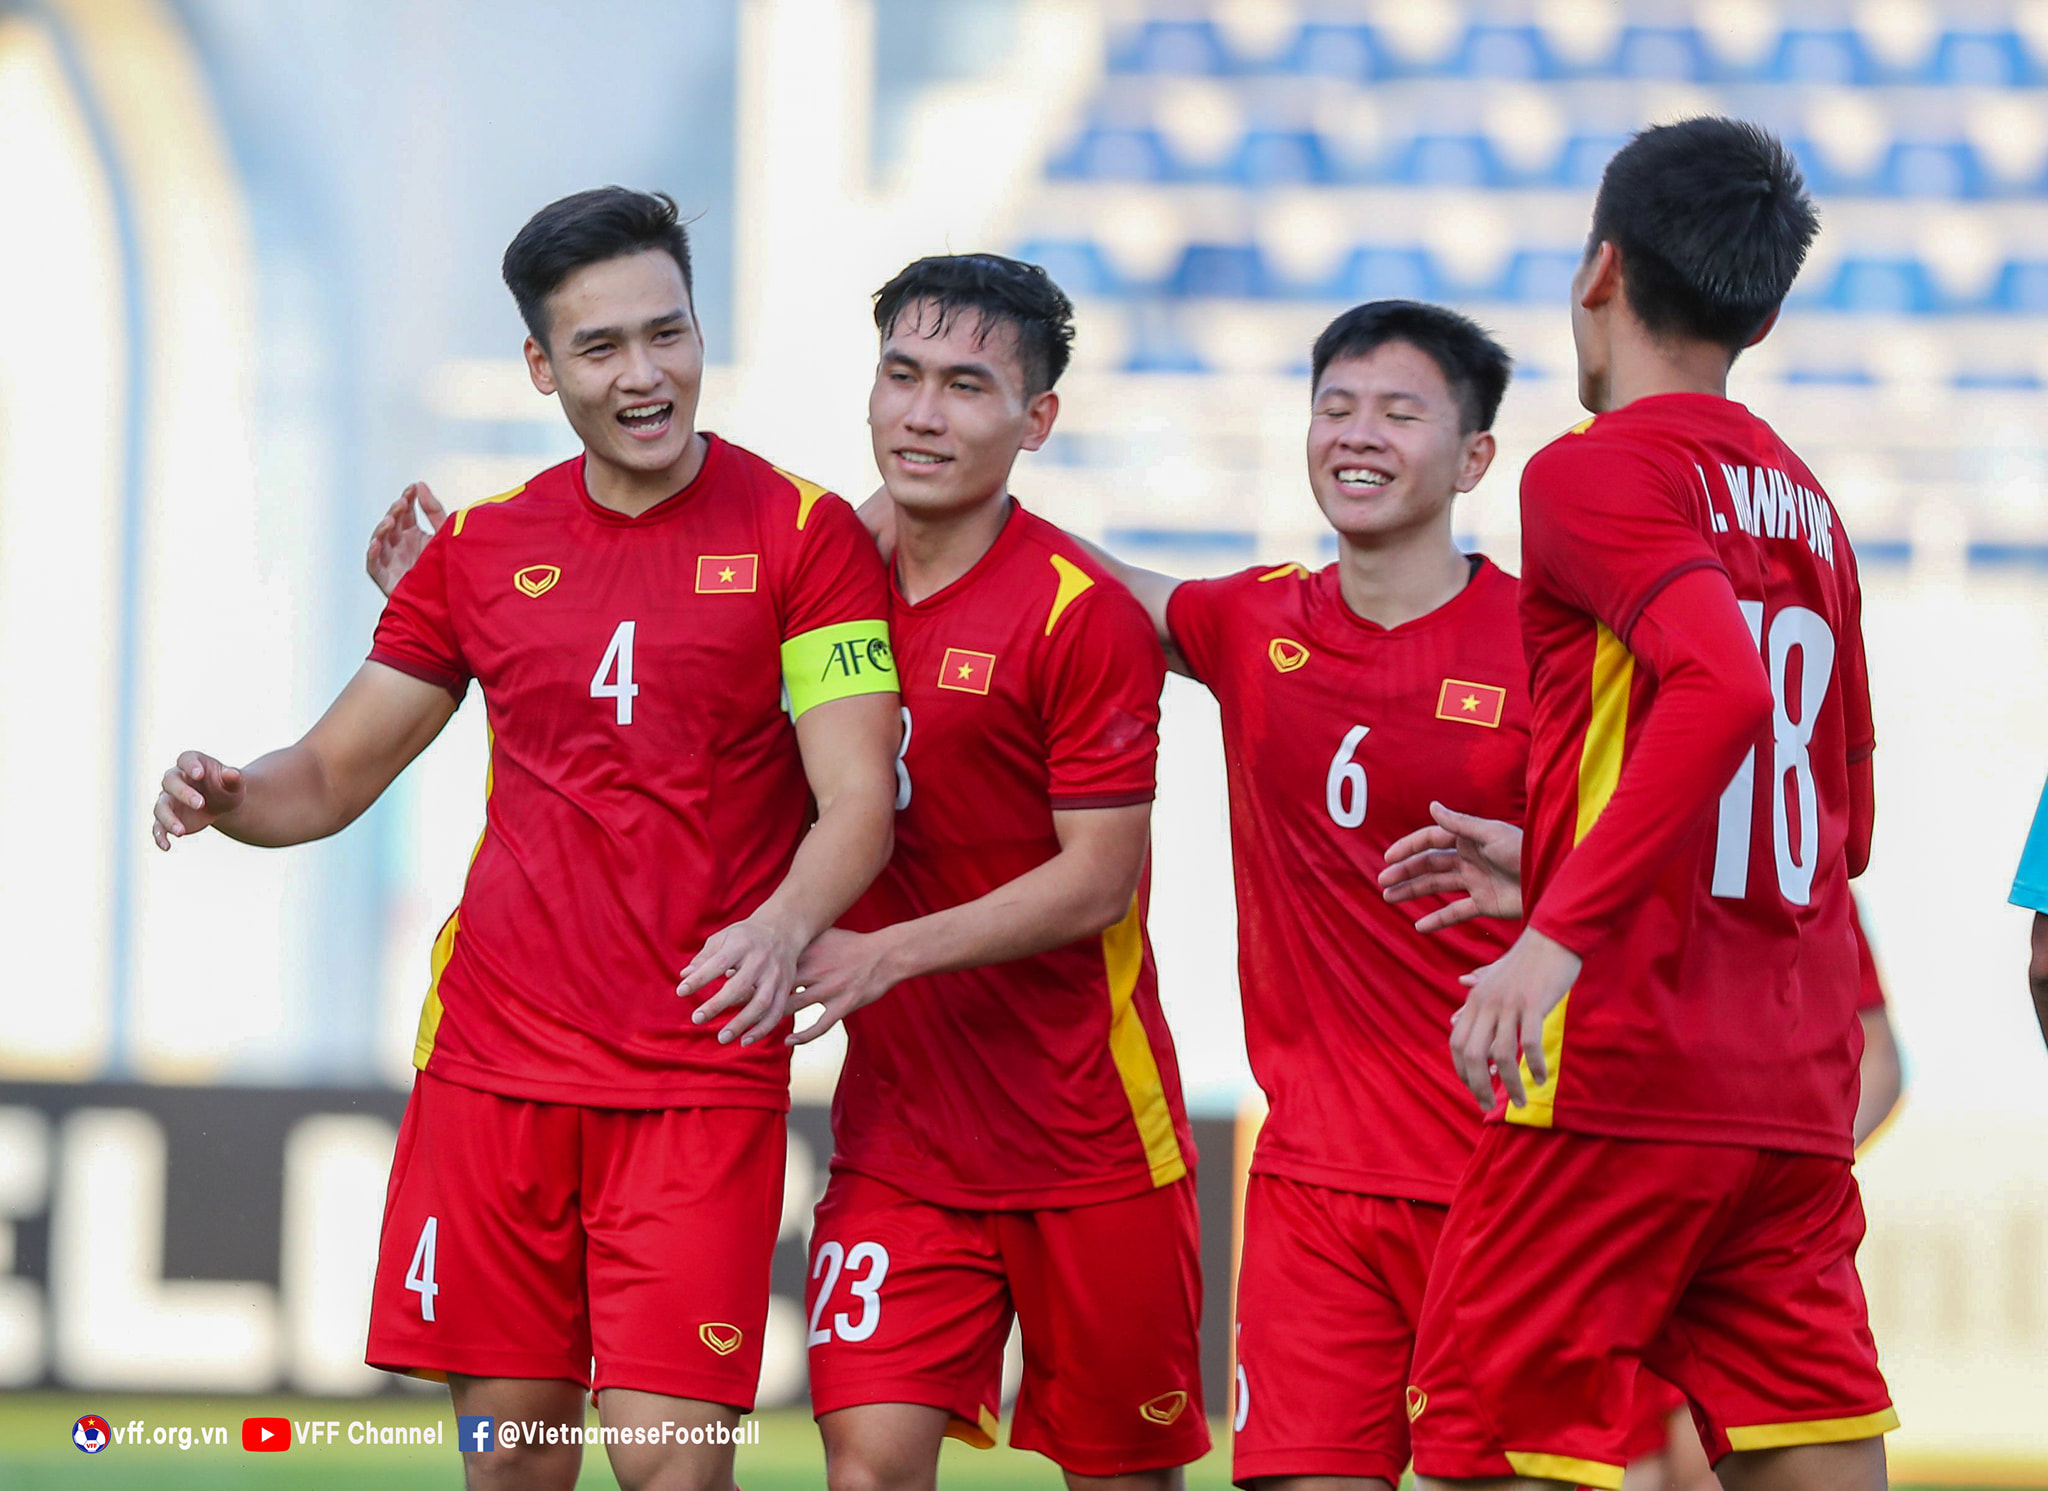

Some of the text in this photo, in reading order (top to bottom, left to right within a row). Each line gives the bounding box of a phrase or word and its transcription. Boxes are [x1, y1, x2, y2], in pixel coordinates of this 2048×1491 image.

[590, 621, 639, 725] 4
[821, 638, 893, 682] AFC
[1326, 725, 1371, 828] 6
[405, 1216, 439, 1322] 4
[807, 1241, 890, 1348] 23
